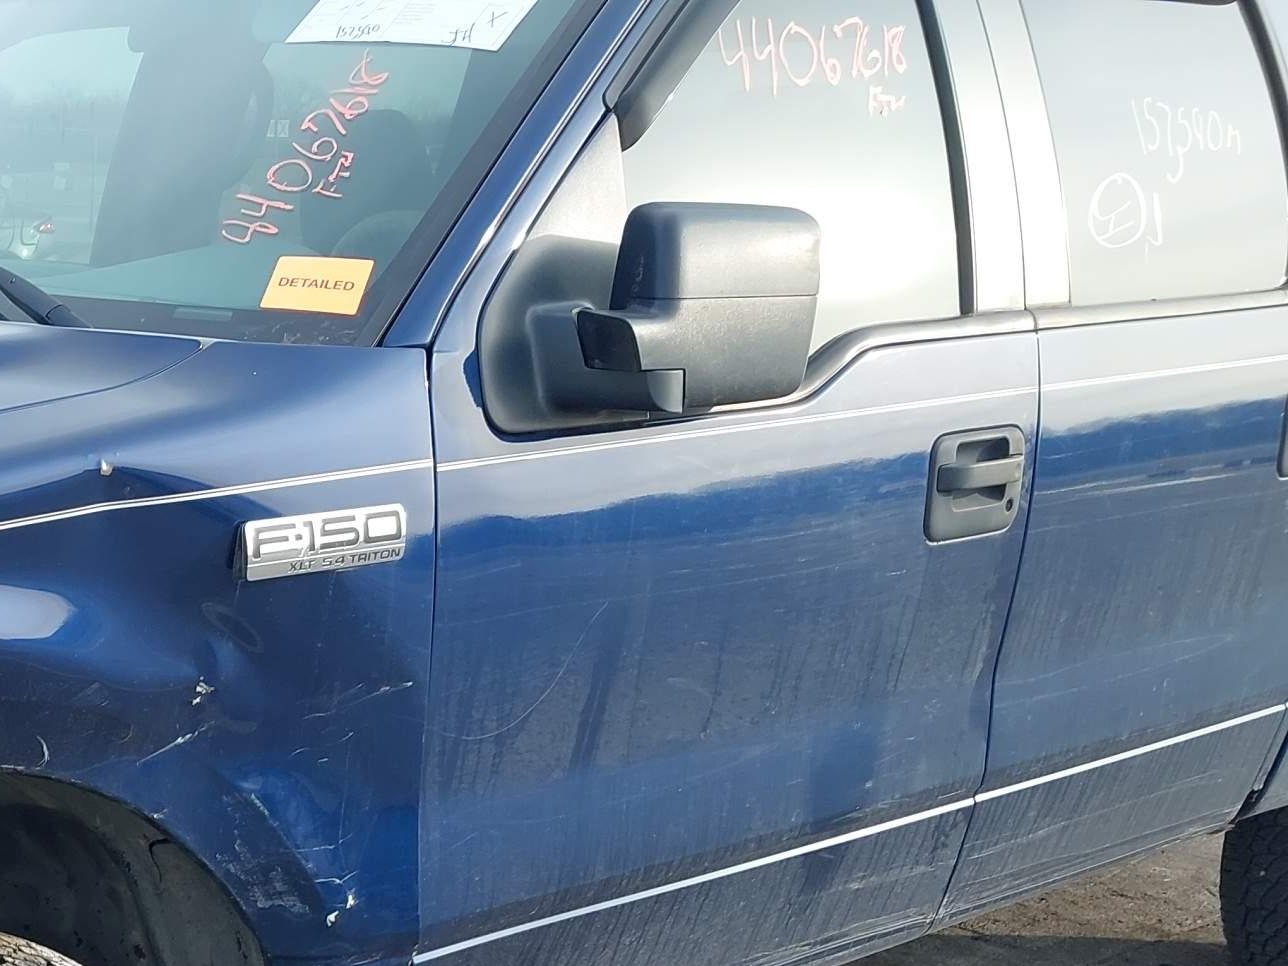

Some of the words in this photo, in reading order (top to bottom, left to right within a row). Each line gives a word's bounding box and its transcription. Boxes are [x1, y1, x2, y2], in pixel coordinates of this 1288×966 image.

[718, 16, 908, 97] 44067618
[278, 277, 355, 292] DETAILED
[252, 510, 403, 559] F-150
[288, 557, 316, 572] XLT
[350, 548, 401, 566] TRITON
